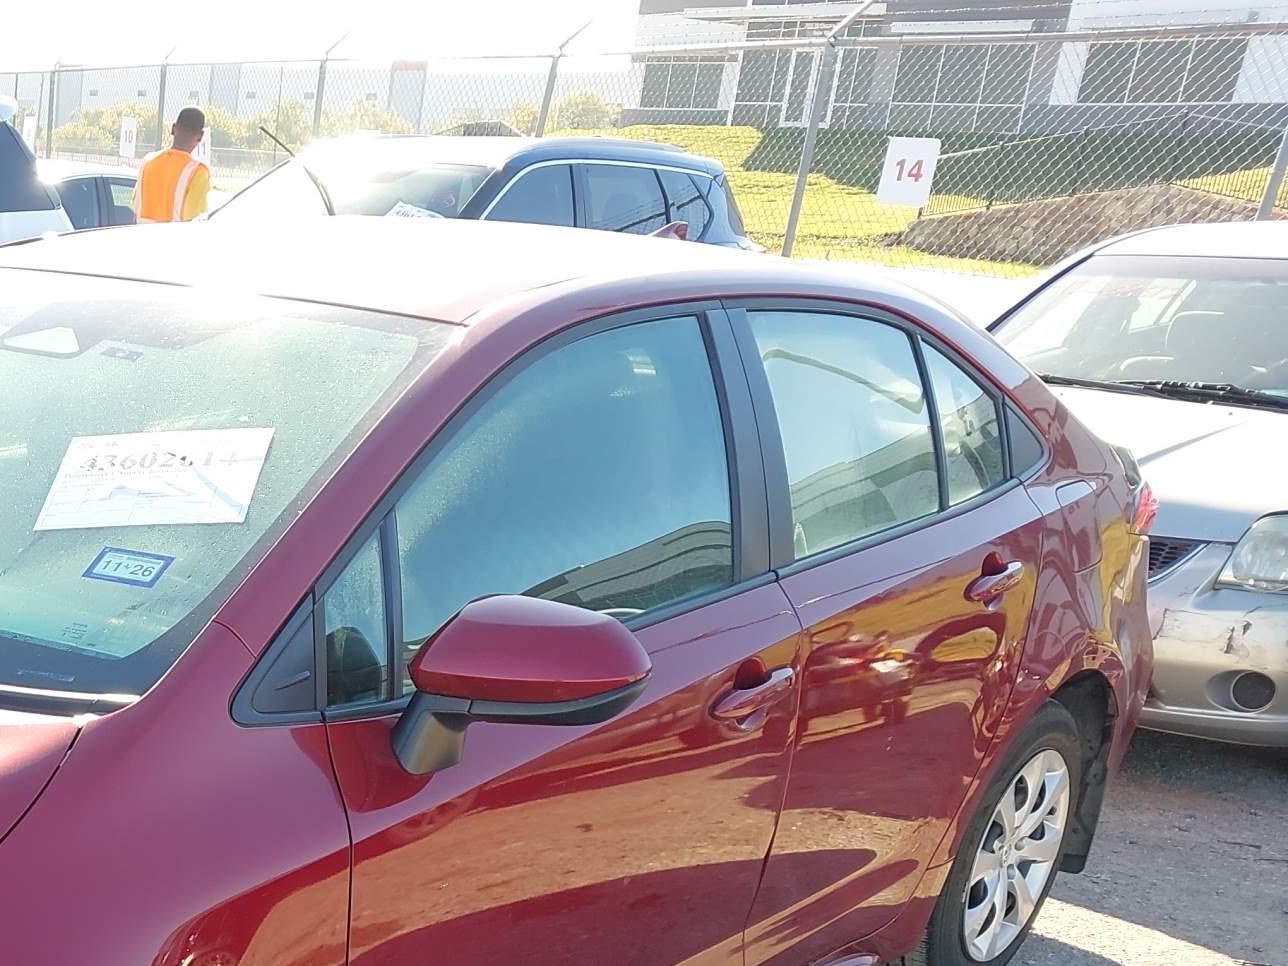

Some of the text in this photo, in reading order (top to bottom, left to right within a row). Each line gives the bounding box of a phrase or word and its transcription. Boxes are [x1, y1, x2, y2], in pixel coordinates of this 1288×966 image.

[124, 129, 134, 144] 10
[895, 158, 924, 182] 14
[101, 559, 156, 577] 11 26
